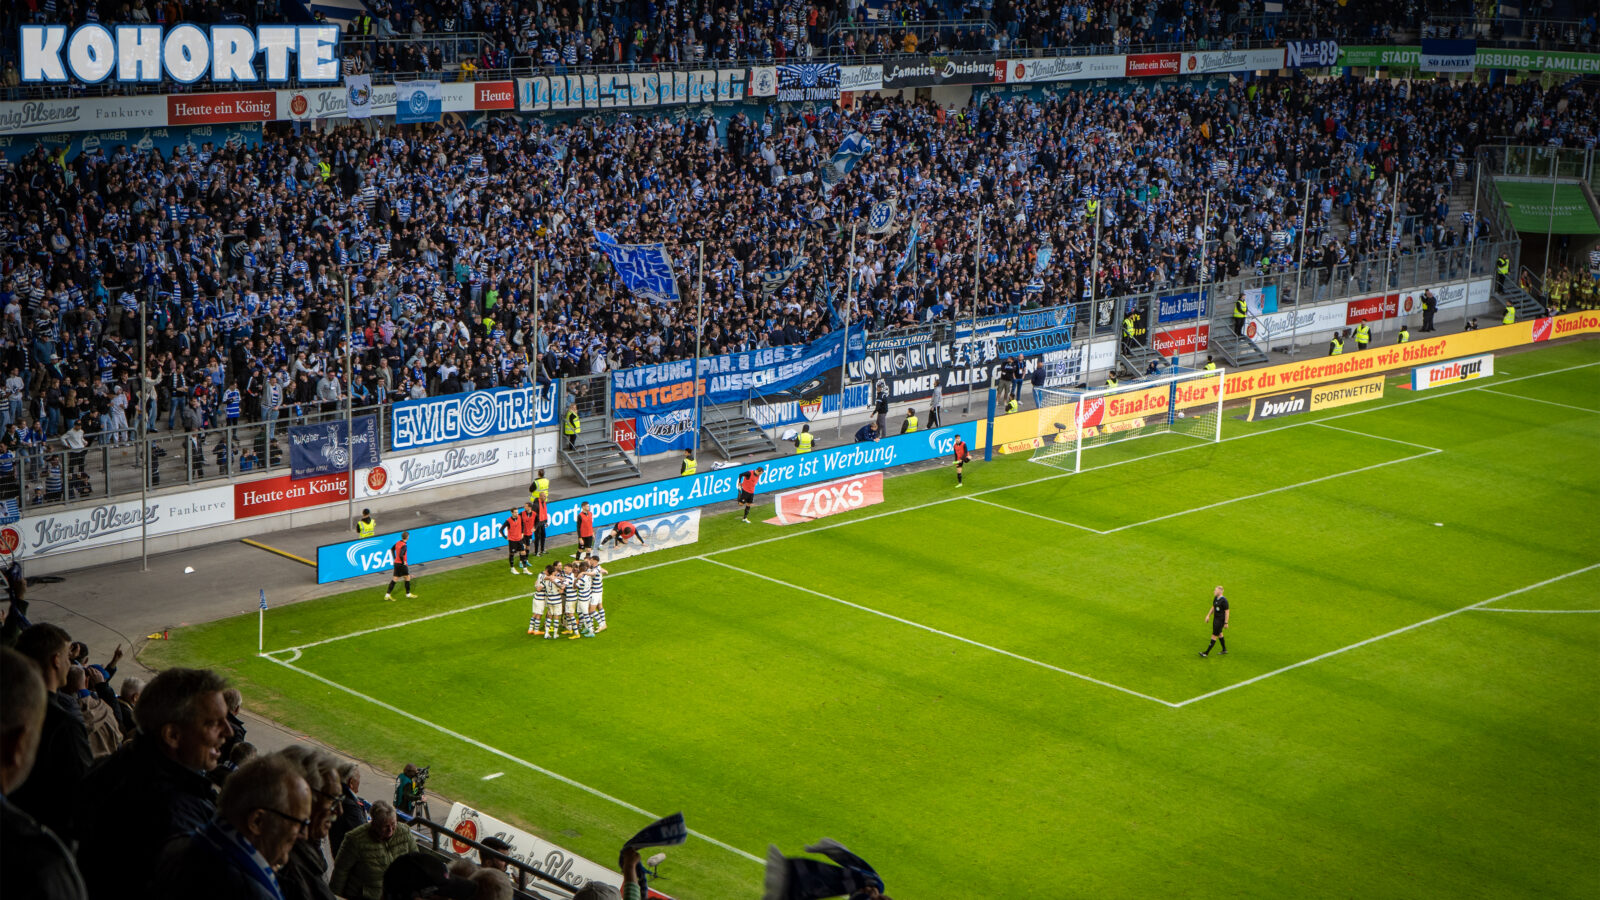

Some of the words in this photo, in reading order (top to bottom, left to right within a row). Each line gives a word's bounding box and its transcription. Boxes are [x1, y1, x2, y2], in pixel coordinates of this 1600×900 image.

[884, 62, 936, 82] Fanatics
[941, 61, 995, 78] Duisburg
[1030, 61, 1054, 77] König
[1053, 57, 1083, 73] Pilsener
[1129, 61, 1148, 71] Heute
[1148, 60, 1159, 69] ein
[1159, 58, 1179, 71] König
[1201, 54, 1223, 69] König
[1428, 58, 1439, 66] SO
[1441, 58, 1471, 67] LONELY
[840, 69, 861, 87] önig
[480, 89, 511, 102] Heute
[519, 78, 641, 105] Meidericher
[642, 75, 744, 104] Spielverein
[0, 110, 22, 129] nig
[21, 101, 80, 124] Pilsener
[96, 107, 154, 119] Fankurve
[175, 103, 212, 116] Heute
[214, 102, 233, 114] ein
[236, 100, 271, 117] König
[1350, 306, 1368, 317] Heute
[1368, 305, 1378, 315] ein
[1532, 317, 1552, 341] Sinalco
[1555, 315, 1600, 333] Sinalco.
[997, 331, 1070, 354] WEDAUSTADION
[1153, 339, 1173, 351] Heute
[1175, 336, 1185, 347] ein
[613, 360, 693, 388] SATZUNG
[698, 355, 736, 376] PAR.
[739, 354, 749, 370] 8
[755, 347, 790, 367] ABS.
[848, 343, 951, 378] KOHORTE
[1429, 359, 1482, 380] trinkgut
[946, 366, 989, 387] ALLES
[1109, 393, 1169, 417] Sinalco.
[1175, 385, 1208, 404] Oder
[1212, 374, 1254, 397] willst
[1258, 371, 1276, 389] du
[1280, 353, 1374, 385] weitermachen
[1377, 349, 1399, 366] wie
[1402, 340, 1447, 361] bisher?
[1260, 395, 1305, 417] bwin
[1314, 382, 1382, 404] SPORTWETTEN
[393, 398, 461, 448] EWIG
[495, 382, 557, 432] TREU
[367, 418, 378, 463] DUISBURG
[937, 437, 955, 454] VS
[1008, 441, 1031, 452] Sinalco
[397, 457, 445, 485] König
[444, 447, 500, 473] Pilsener
[243, 490, 283, 506] Heute
[286, 485, 305, 499] ein
[309, 477, 348, 495] König
[798, 481, 864, 517] ZOXS
[361, 549, 395, 572] VSA
[439, 524, 466, 549] 50
[687, 474, 731, 500] Alles
[798, 458, 819, 478] ist
[822, 444, 897, 471] Werbung.
[32, 517, 90, 548] König
[90, 505, 160, 534] Pilsener
[169, 501, 226, 517] Fankurve
